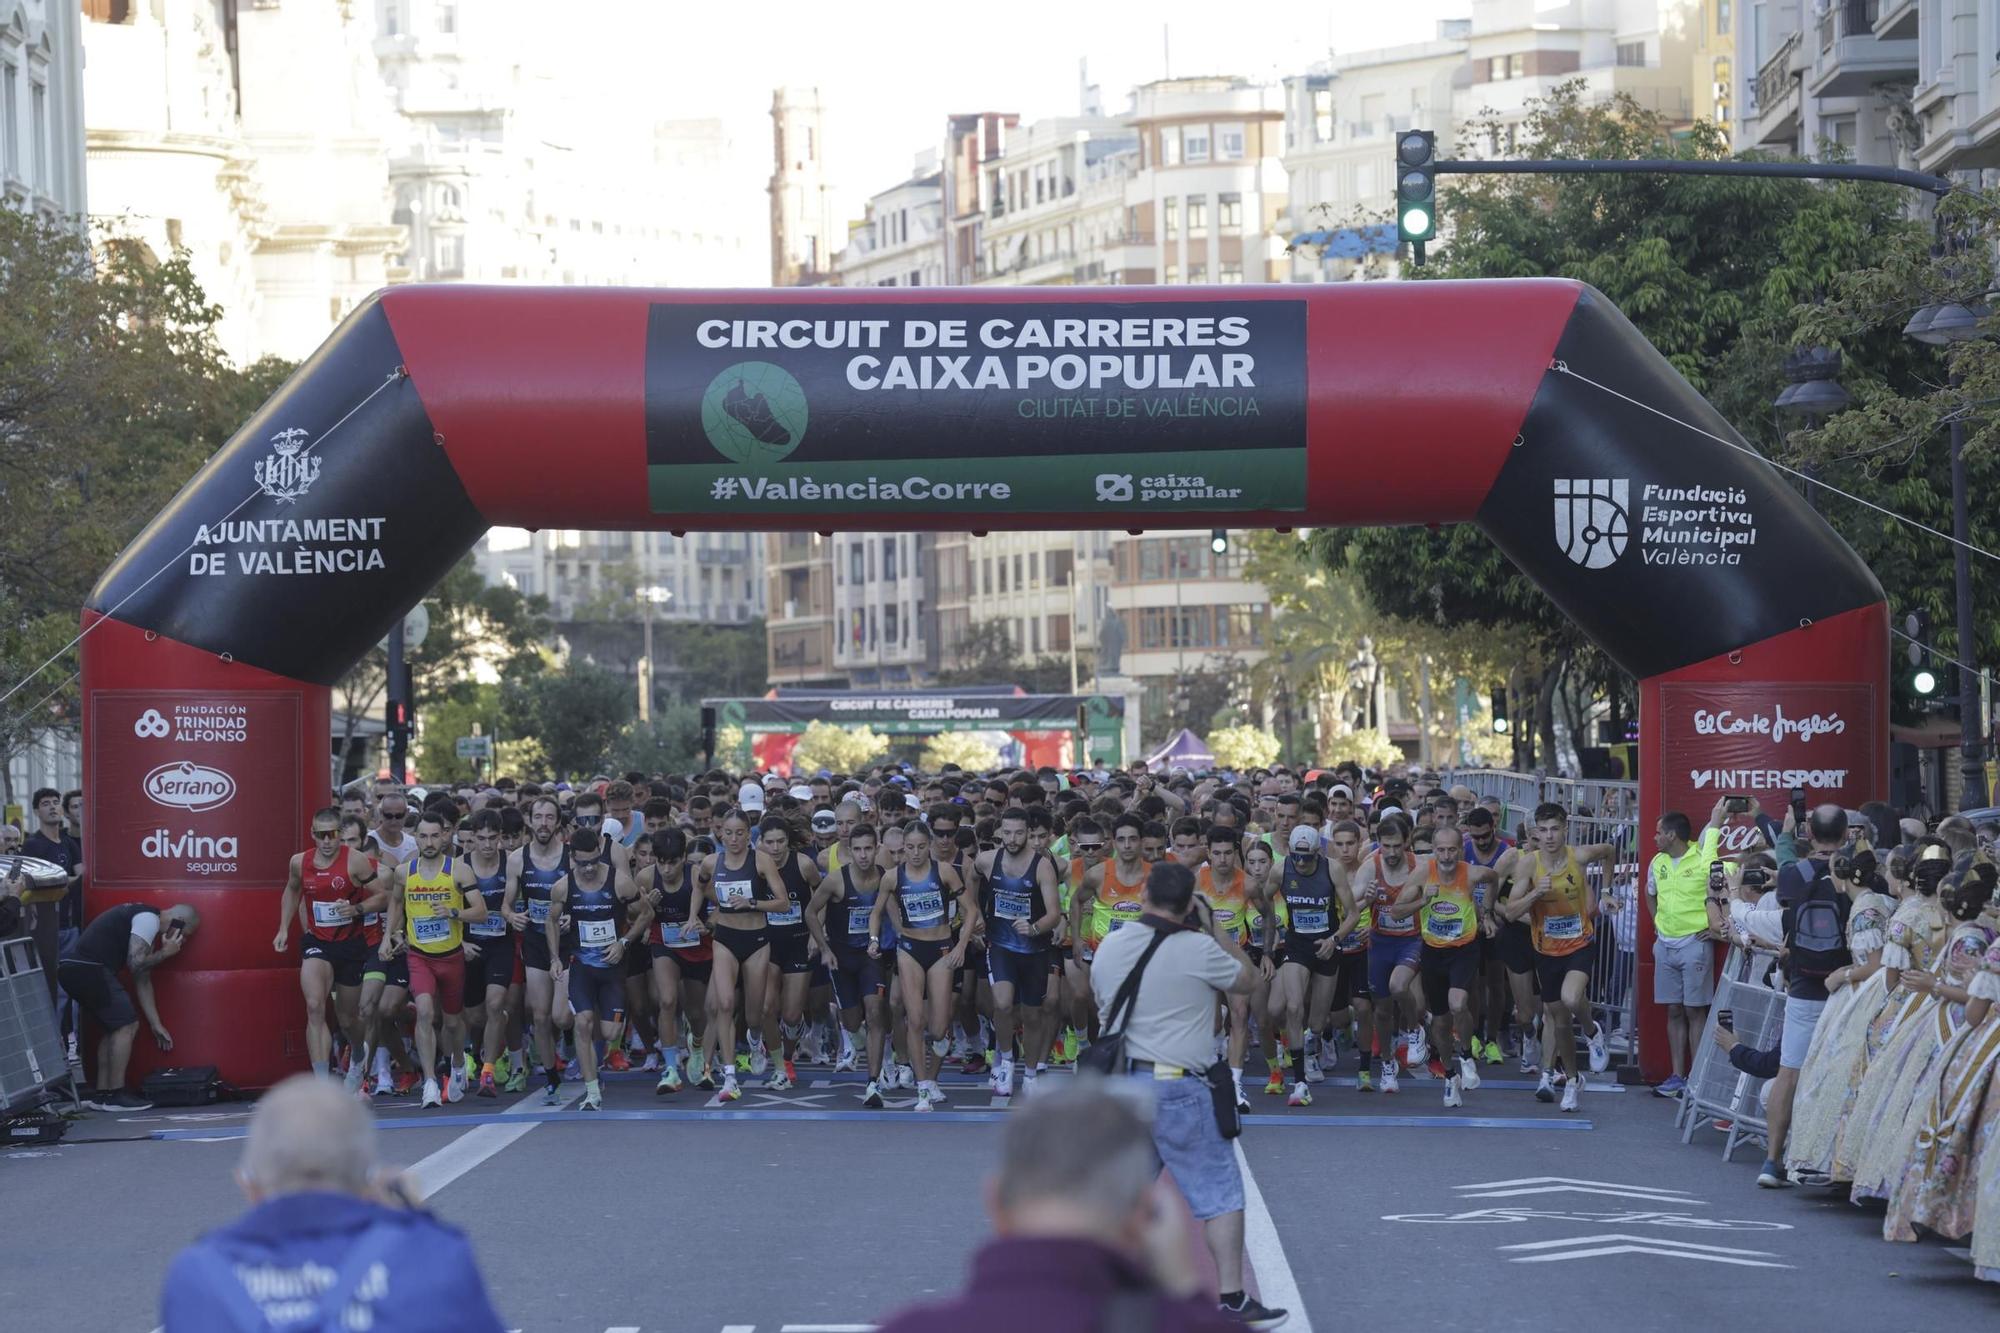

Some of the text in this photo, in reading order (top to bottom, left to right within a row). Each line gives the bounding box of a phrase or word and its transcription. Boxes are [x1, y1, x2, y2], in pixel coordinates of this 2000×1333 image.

[697, 316, 1250, 349] CIRCUIT DE CARRERES
[846, 353, 1256, 391] CAIXA POPULAR
[1018, 393, 1261, 420] CIUTAT DE VALÈNCIA
[710, 476, 1012, 501] #ValènciaCorre
[1140, 474, 1206, 488] caixa
[1140, 486, 1242, 502] popular
[1642, 484, 1747, 505] Fundació
[1642, 506, 1753, 527] Esportiva
[192, 517, 386, 545] AJUNTAMENT
[1642, 527, 1757, 548] Municipal
[189, 545, 386, 576] DE VALÈNCIA
[1642, 548, 1741, 565] València
[175, 704, 247, 714] FUNDACIÓN
[830, 699, 955, 710] CIRCUIT DE CARRERES
[908, 708, 999, 719] CAIXA POPULAR
[174, 716, 247, 729] TRINIDAD
[1694, 704, 1845, 743] El Corte Inglés
[174, 729, 247, 742] ALFONSO
[153, 775, 226, 796] Serrano
[1714, 769, 1846, 789] INTERSPORT
[141, 828, 237, 858] divina
[186, 862, 237, 875] seguros
[408, 892, 451, 901] runners
[728, 887, 744, 896] 24
[907, 899, 940, 912] 2158
[1000, 899, 1022, 911] 2200
[417, 923, 441, 933] 2213
[592, 926, 607, 936] 21
